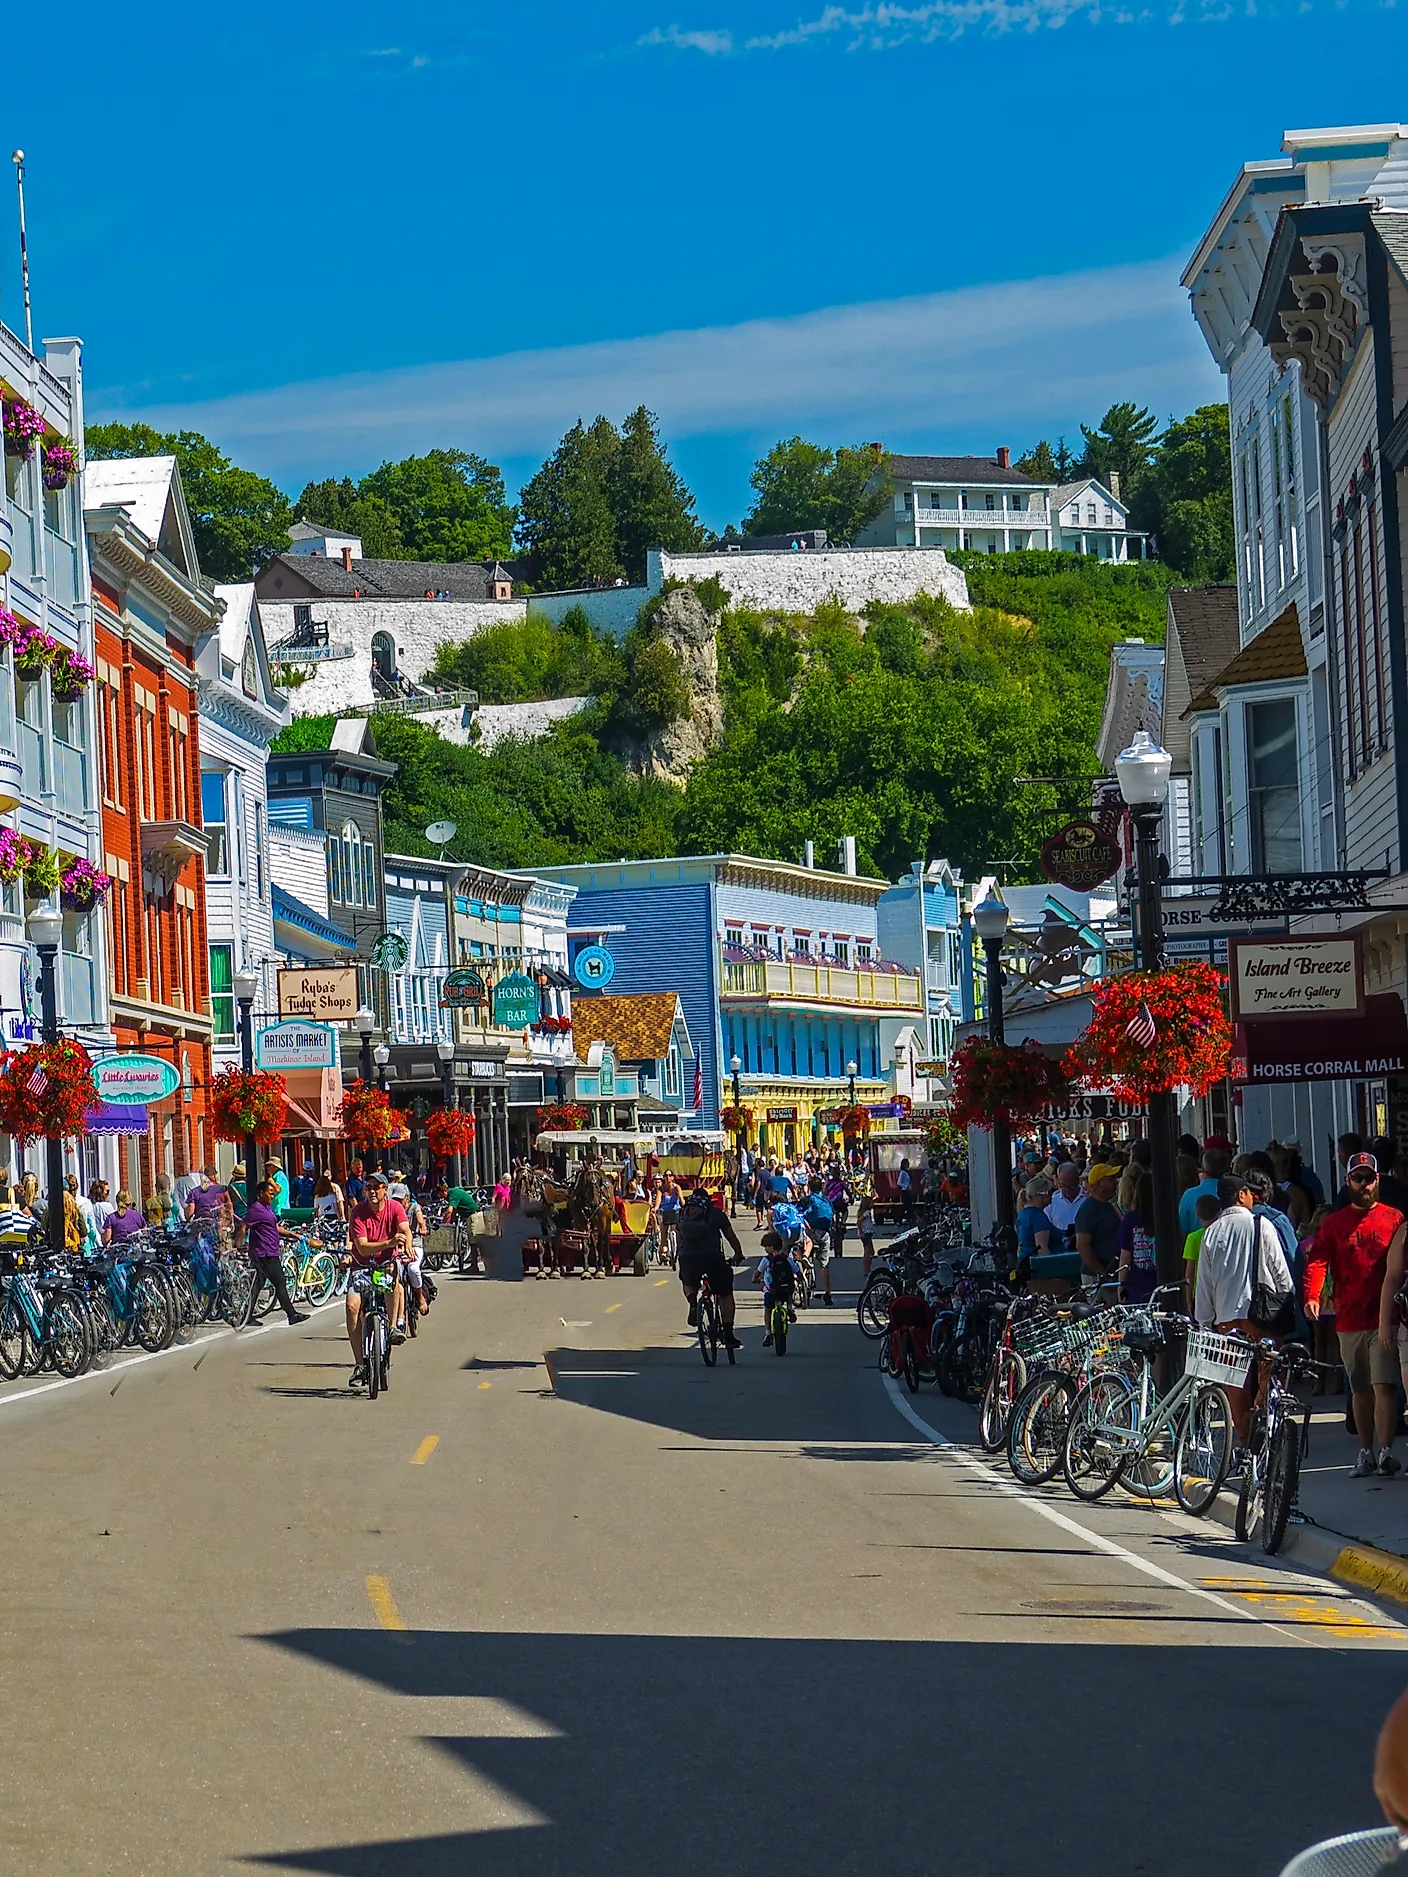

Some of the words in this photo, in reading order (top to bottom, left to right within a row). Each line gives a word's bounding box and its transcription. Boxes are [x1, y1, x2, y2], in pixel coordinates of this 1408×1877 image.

[1161, 910, 1202, 926] ORSE
[1245, 957, 1292, 977] Island
[1293, 957, 1352, 975] Breeze
[301, 978, 336, 997] Ryba's
[497, 986, 535, 999] HORN'S
[1254, 987, 1278, 1002] Fine
[1279, 987, 1302, 999] Art
[1304, 986, 1342, 1000] Gallery
[284, 995, 317, 1013] Fudge
[319, 995, 352, 1010] Shops
[506, 1010, 527, 1022] BAR
[264, 1034, 294, 1048] ARTISTS
[295, 1033, 327, 1047] MARKET
[267, 1056, 302, 1064] Mackinac
[304, 1053, 325, 1063] Island
[1253, 1063, 1302, 1078] HORSE
[1304, 1060, 1362, 1076] CORRAL
[1365, 1057, 1405, 1073] MALL
[102, 1070, 124, 1083] Little
[124, 1070, 160, 1082] Luxuries
[894, 1096, 909, 1104] 3-D
